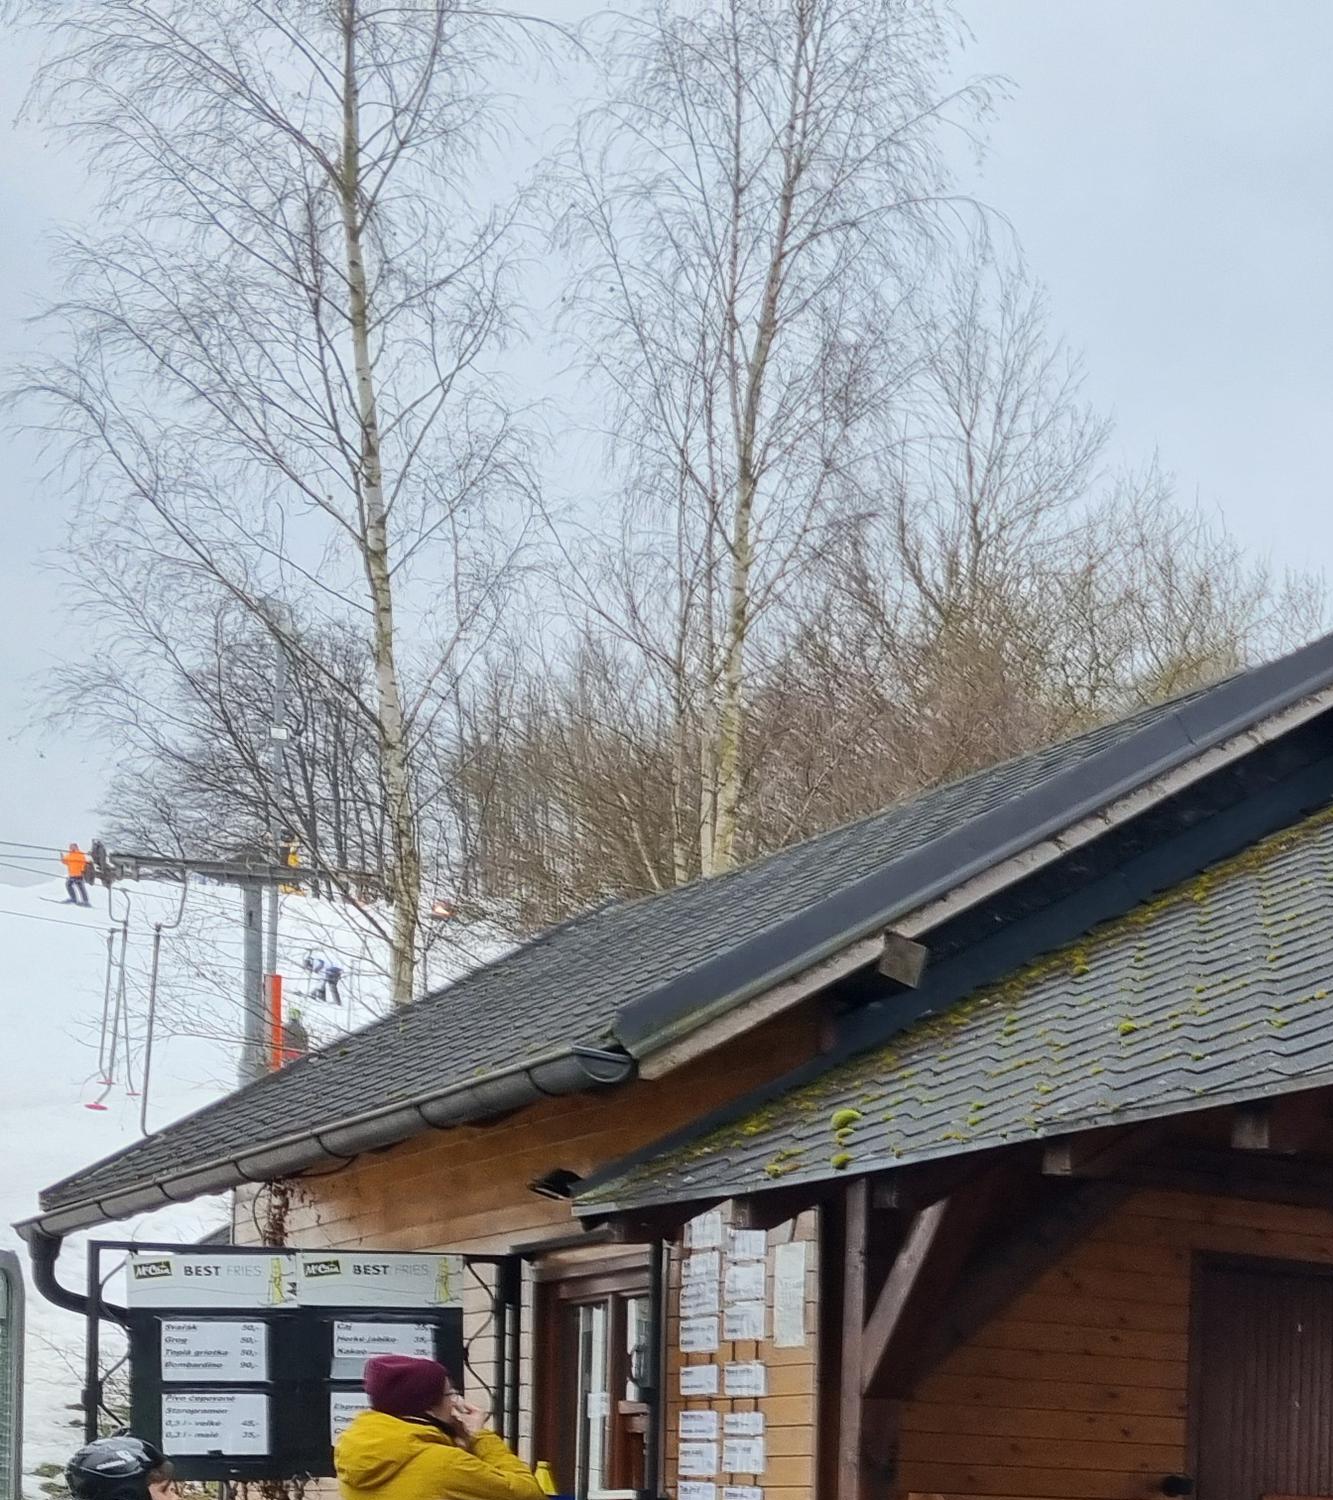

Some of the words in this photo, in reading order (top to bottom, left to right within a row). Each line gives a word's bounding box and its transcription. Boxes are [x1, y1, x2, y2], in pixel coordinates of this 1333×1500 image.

[184, 1265, 221, 1276] BEST
[226, 1265, 262, 1276] FRIES
[353, 1264, 390, 1275] BEST
[395, 1264, 430, 1276] FRIES
[164, 1336, 188, 1344] Grog
